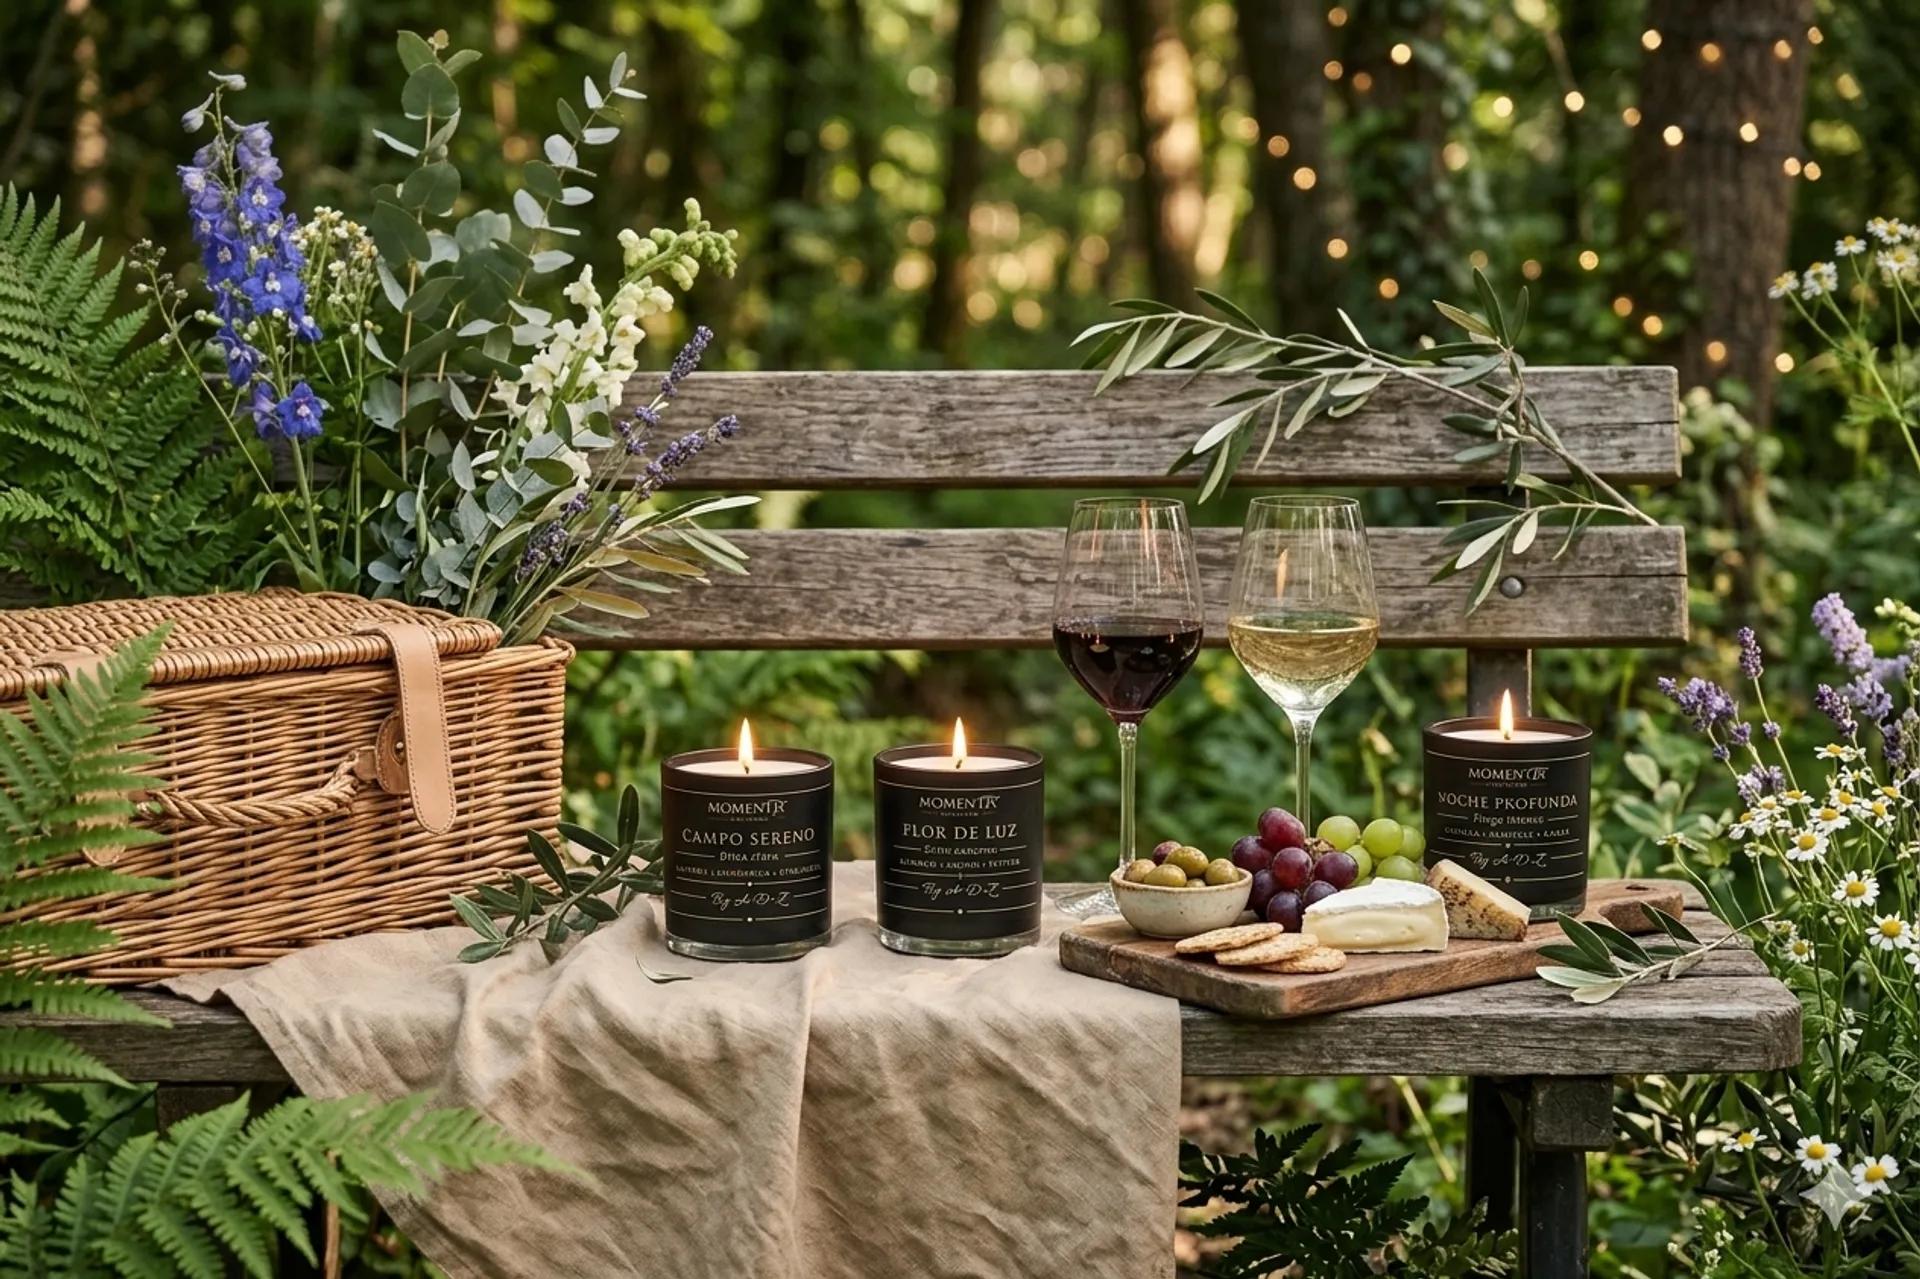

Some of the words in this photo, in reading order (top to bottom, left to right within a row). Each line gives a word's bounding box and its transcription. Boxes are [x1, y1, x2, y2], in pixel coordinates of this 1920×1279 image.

[1438, 792, 1489, 809] NOCHE
[682, 828, 743, 846] CAMPO
[750, 828, 815, 846] SERENO
[903, 823, 947, 840] FLOR
[954, 826, 979, 840] DE
[986, 823, 1018, 840] LUZ
